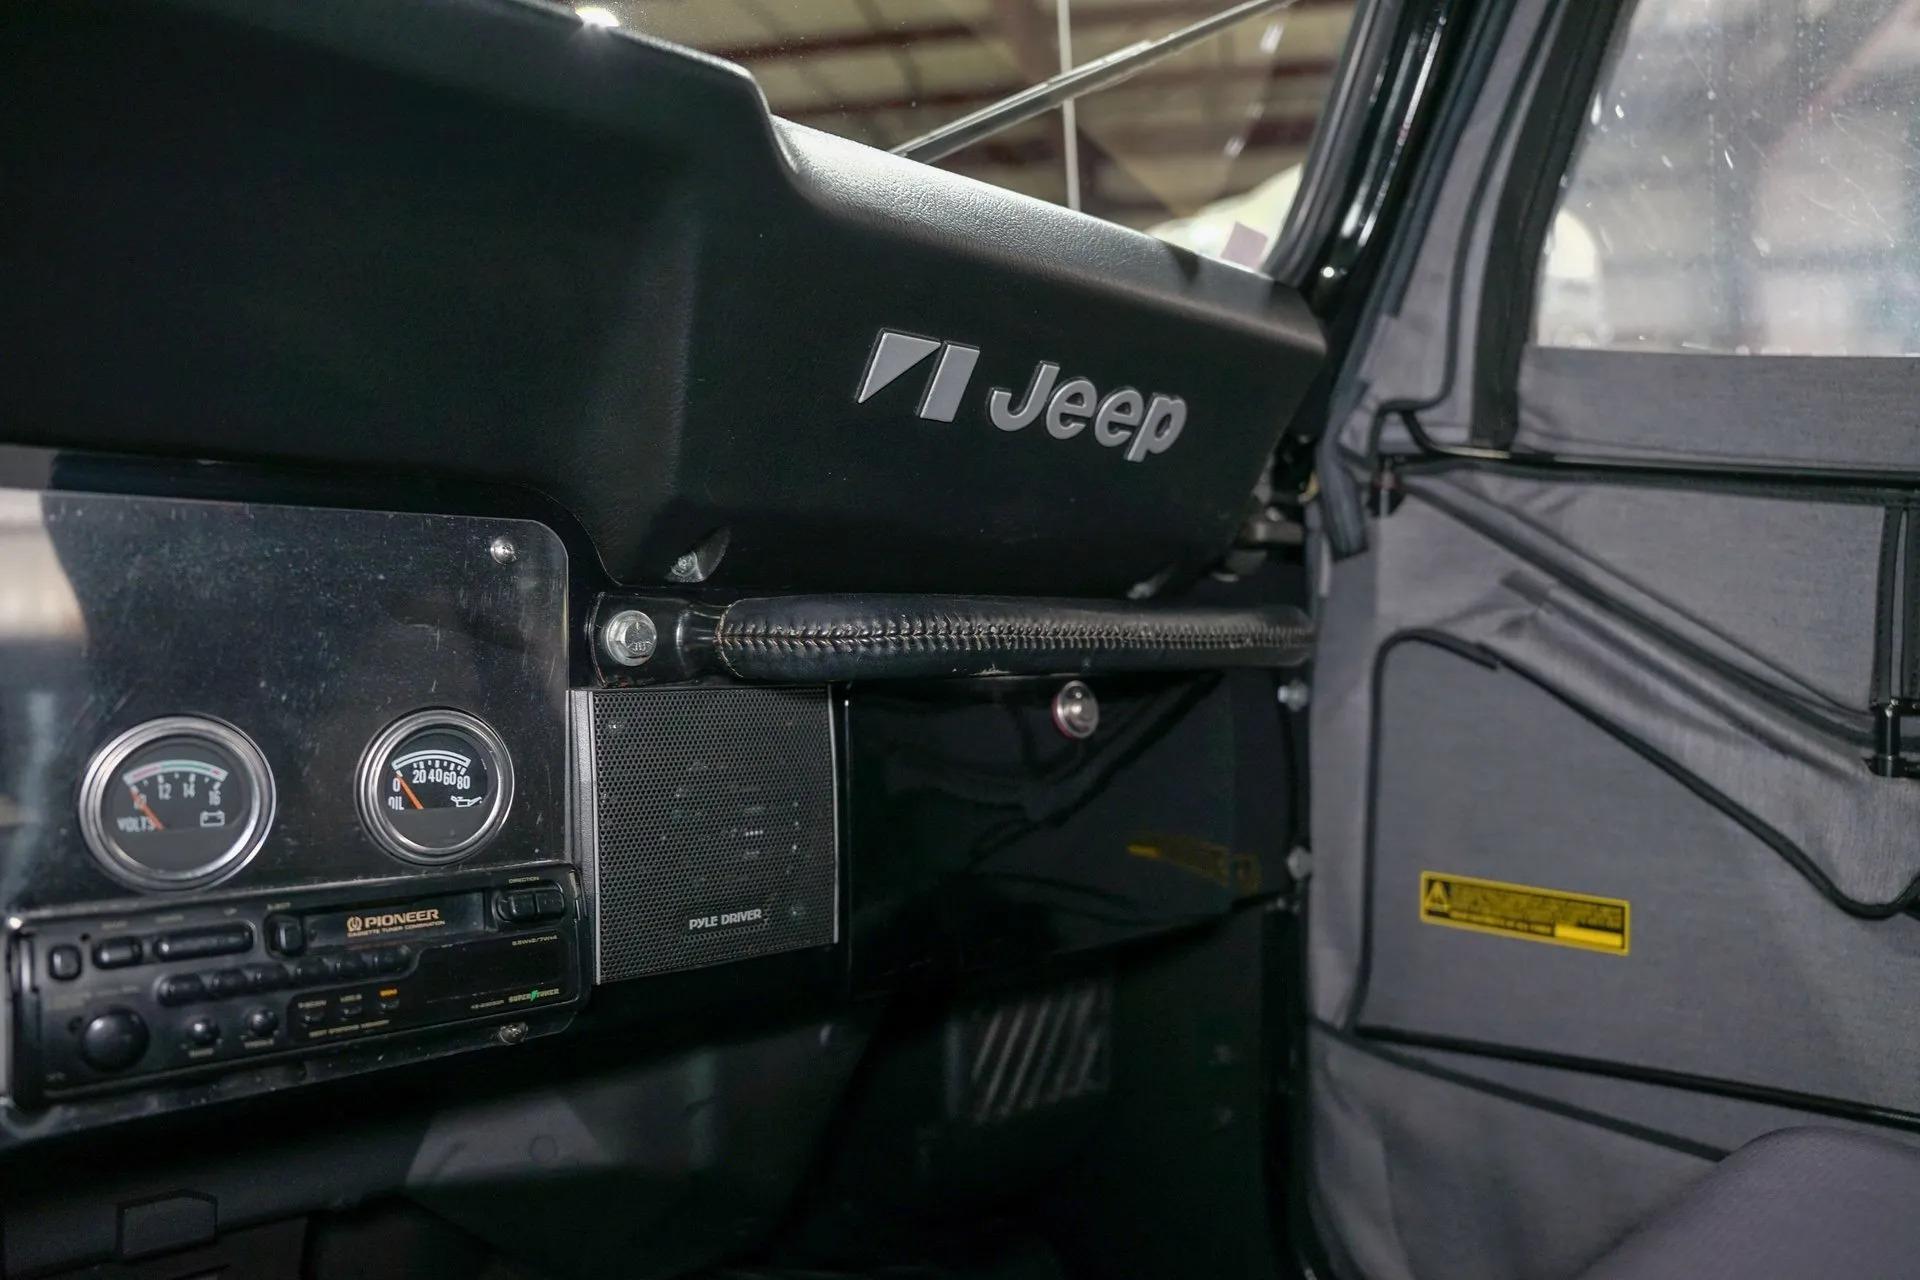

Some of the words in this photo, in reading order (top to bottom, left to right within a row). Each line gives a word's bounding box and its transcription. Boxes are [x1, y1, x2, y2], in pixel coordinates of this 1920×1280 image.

[986, 361, 1187, 463] Jeep
[412, 769, 427, 784] 20
[428, 768, 443, 783] 40
[443, 771, 457, 786] 60
[457, 775, 471, 790] 80
[158, 783, 172, 800] 12
[183, 783, 196, 799] 14
[364, 908, 440, 929] PIONEER
[689, 915, 719, 930] PYLE
[720, 908, 762, 925] DRIVER
